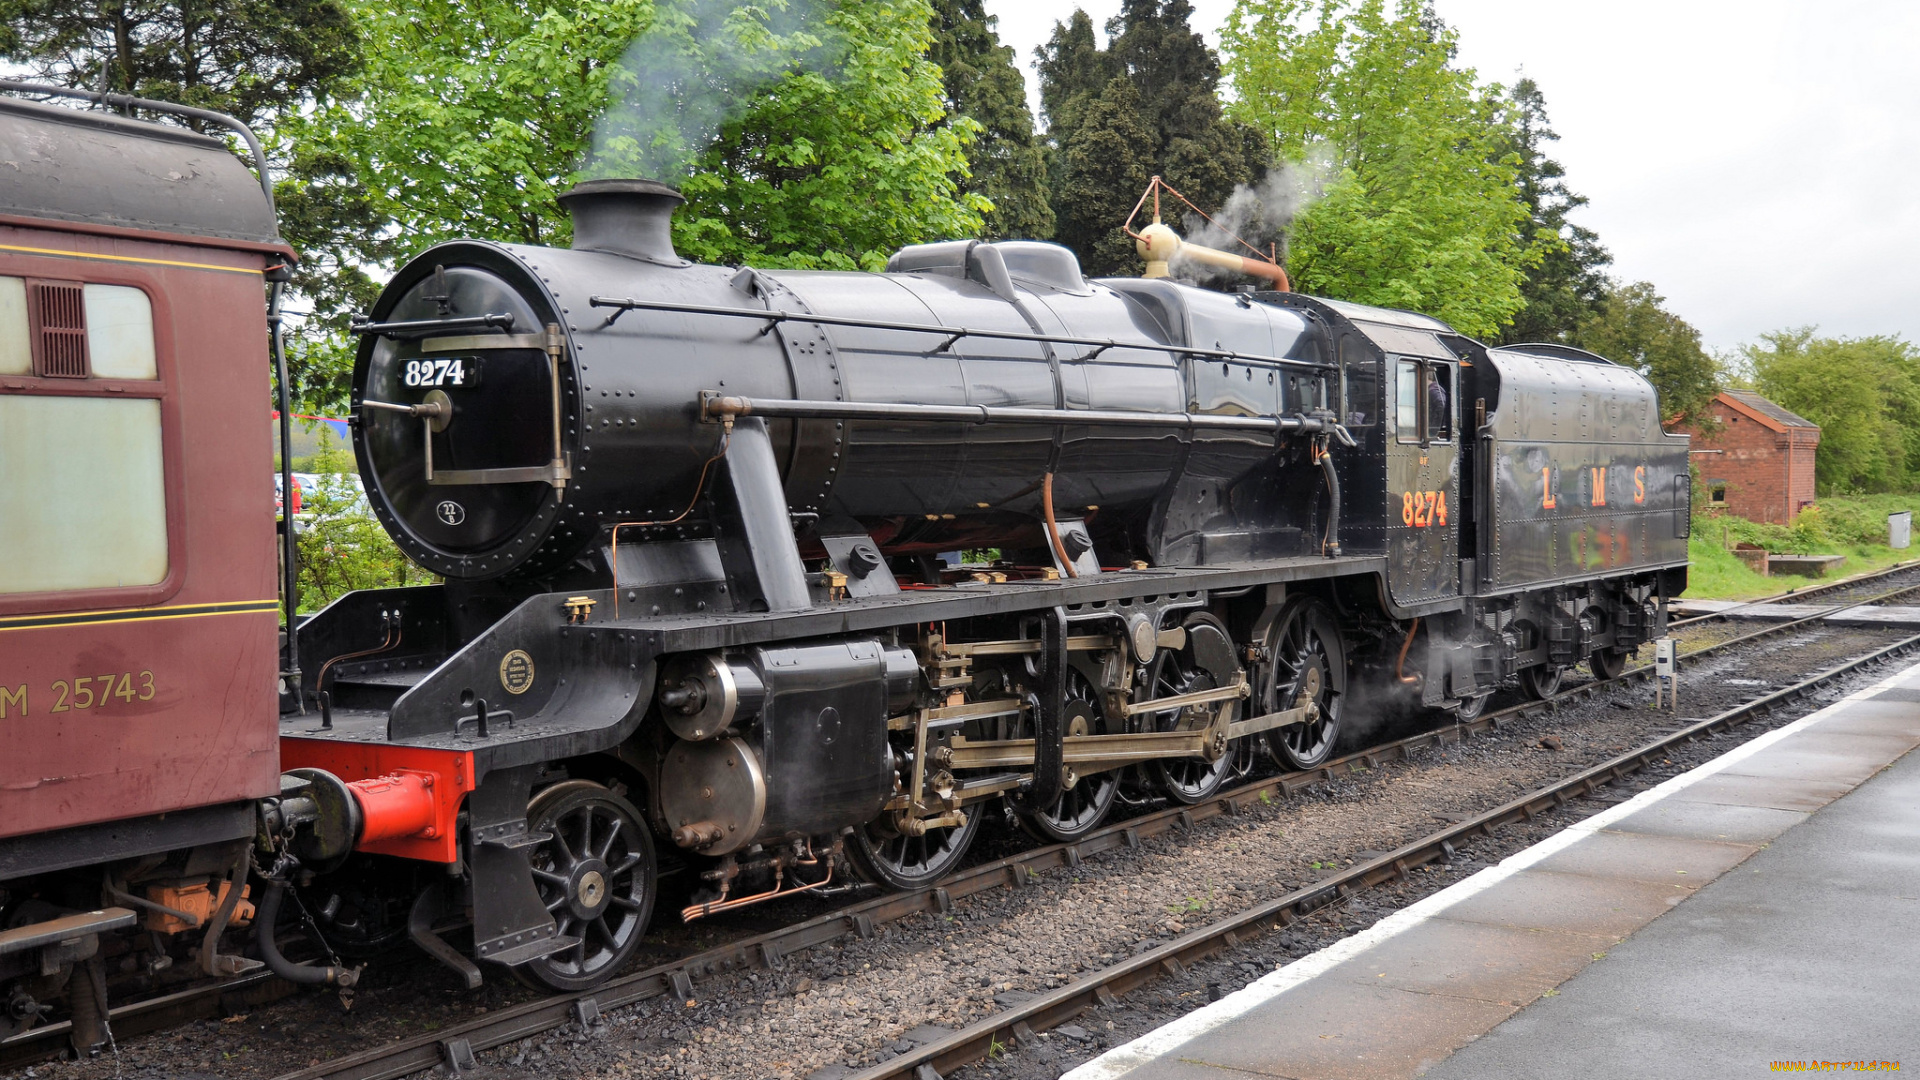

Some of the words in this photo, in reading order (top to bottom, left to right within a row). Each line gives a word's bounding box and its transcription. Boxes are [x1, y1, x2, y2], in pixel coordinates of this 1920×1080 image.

[405, 360, 465, 387] 8274
[443, 503, 457, 516] 22
[449, 514, 456, 524] B
[1402, 490, 1448, 528] 8274
[50, 670, 157, 714] 25743
